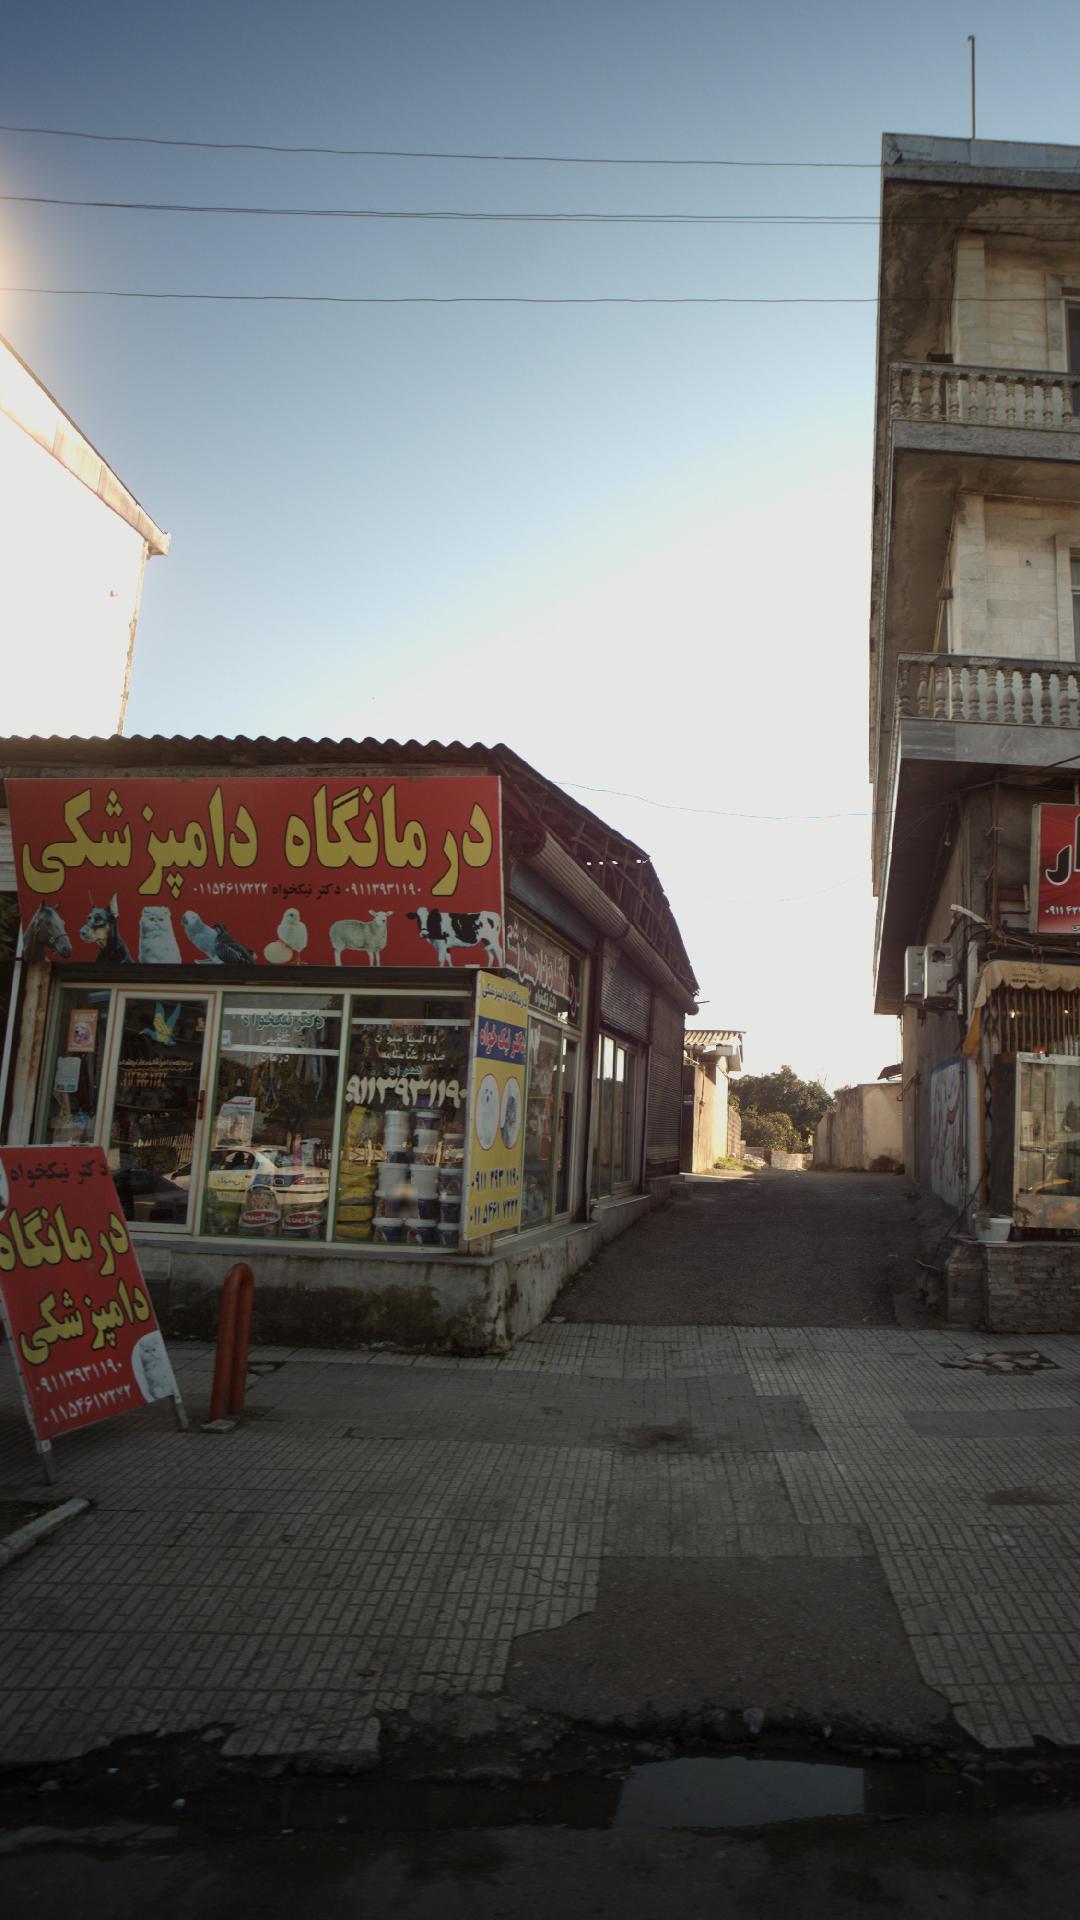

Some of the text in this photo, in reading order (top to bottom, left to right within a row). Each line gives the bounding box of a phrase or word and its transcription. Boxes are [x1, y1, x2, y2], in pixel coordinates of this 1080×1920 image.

[21, 783, 493, 900] درمانگاه دامپزشکی
[271, 882, 312, 900] نیکخواه
[315, 882, 341, 900] دکتر
[345, 882, 422, 896] ۰۹۱۱۳۹۳۱۱۹۰
[10, 1160, 108, 1189] دکتر نیکخواه
[0, 1203, 130, 1277] درمانگاه
[19, 1277, 152, 1366] دامپزشکی
[35, 1358, 123, 1393] ۰۹۱۱۳۹۳۱۱۹۰
